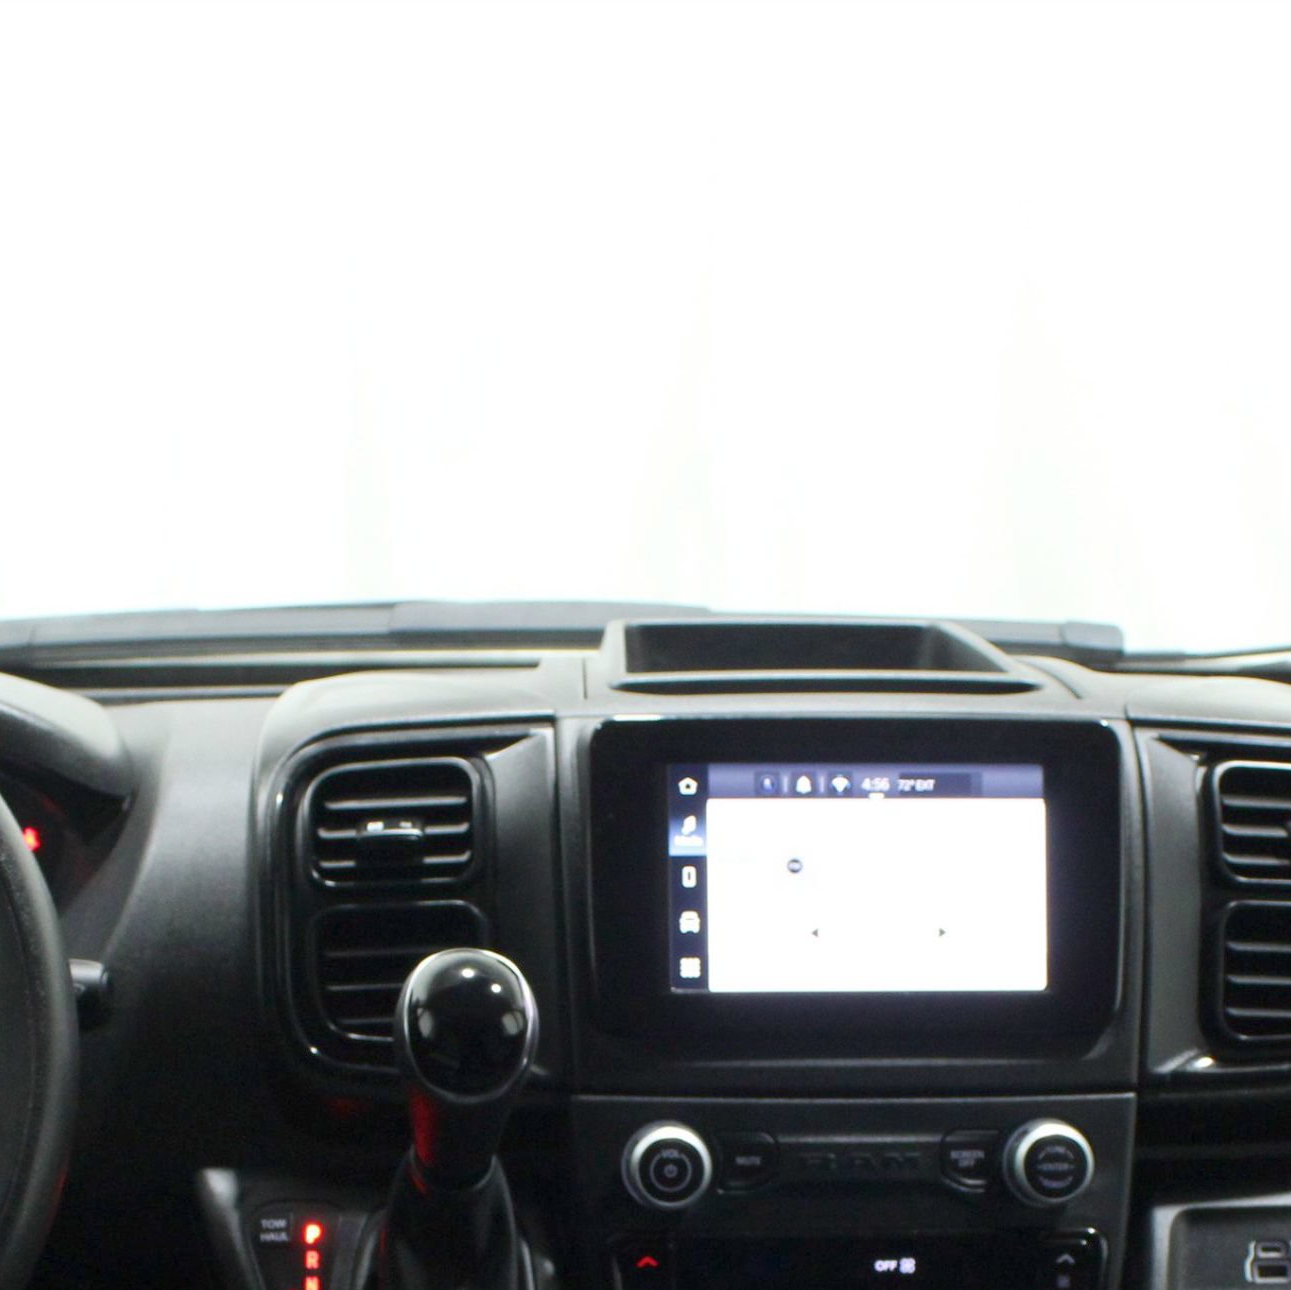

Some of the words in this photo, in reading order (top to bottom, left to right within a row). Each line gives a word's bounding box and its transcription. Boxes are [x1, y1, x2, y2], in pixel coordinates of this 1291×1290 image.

[261, 1219, 287, 1229] TOW
[305, 1223, 322, 1245] P
[305, 1250, 320, 1270] R
[874, 1260, 897, 1272] OFF
